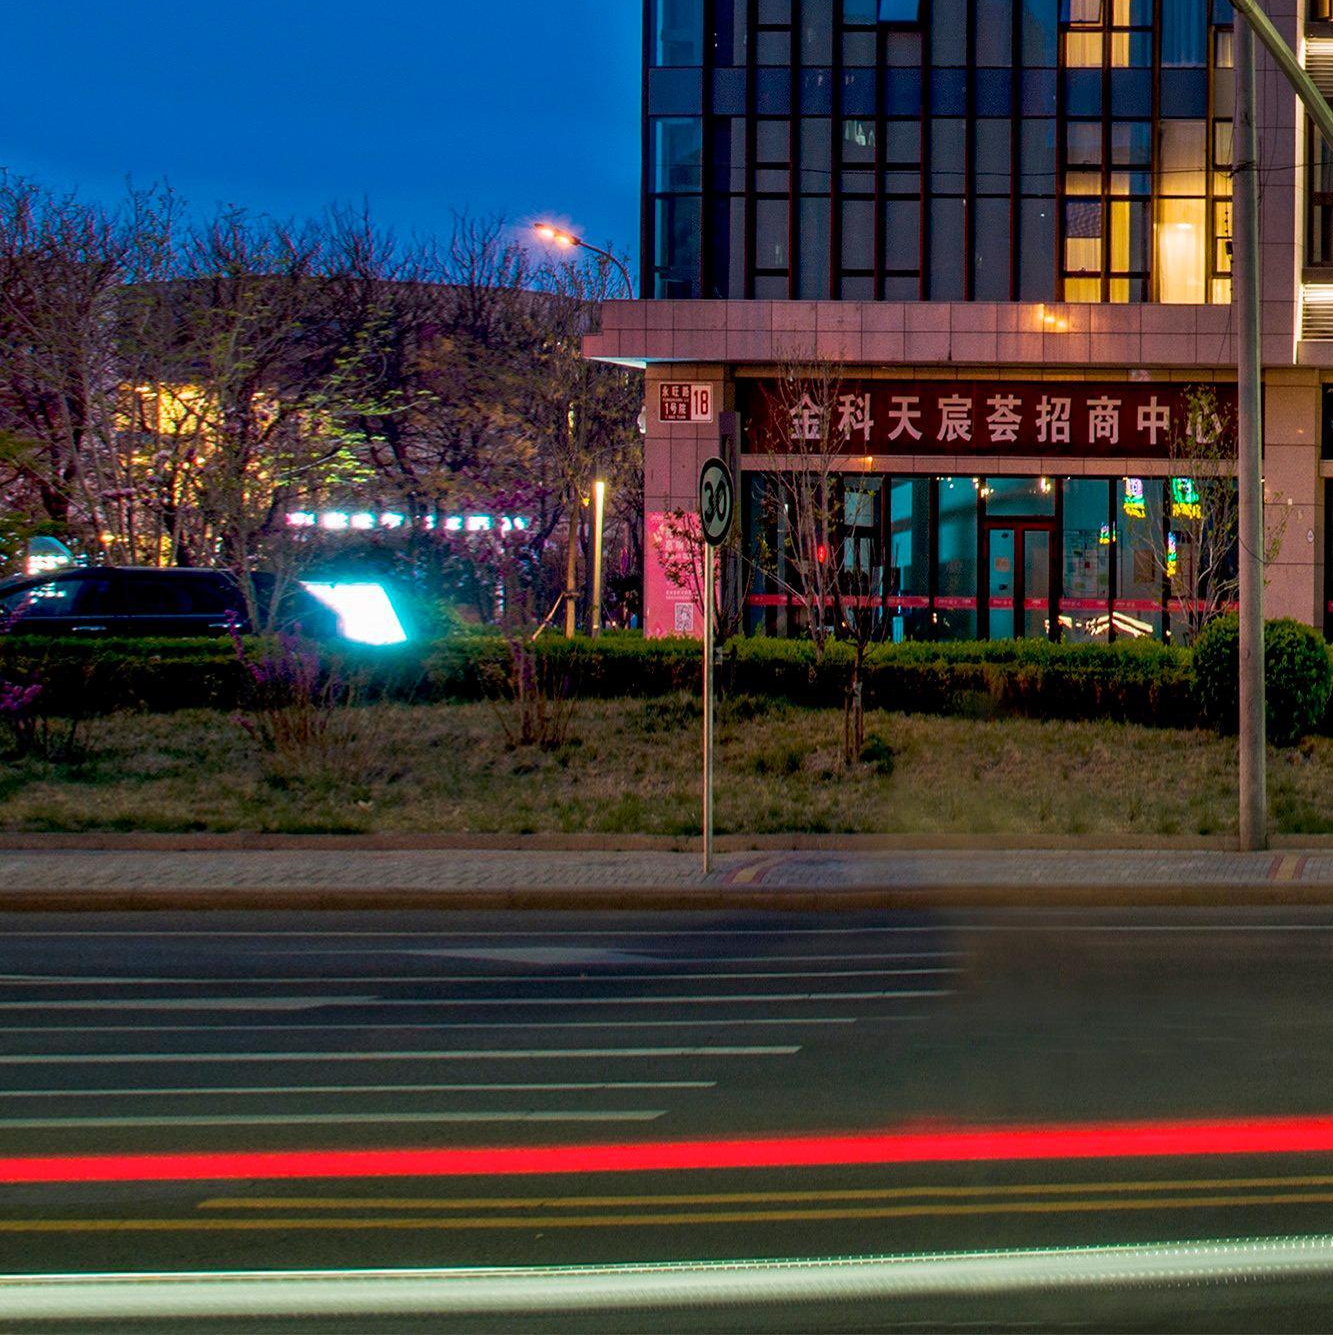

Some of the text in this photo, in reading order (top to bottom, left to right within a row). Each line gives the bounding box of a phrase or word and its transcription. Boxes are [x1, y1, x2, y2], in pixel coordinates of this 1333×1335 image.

[694, 390, 709, 415] 18
[789, 393, 1223, 445] 金科天宸荟招商中心
[704, 478, 727, 522] 30
